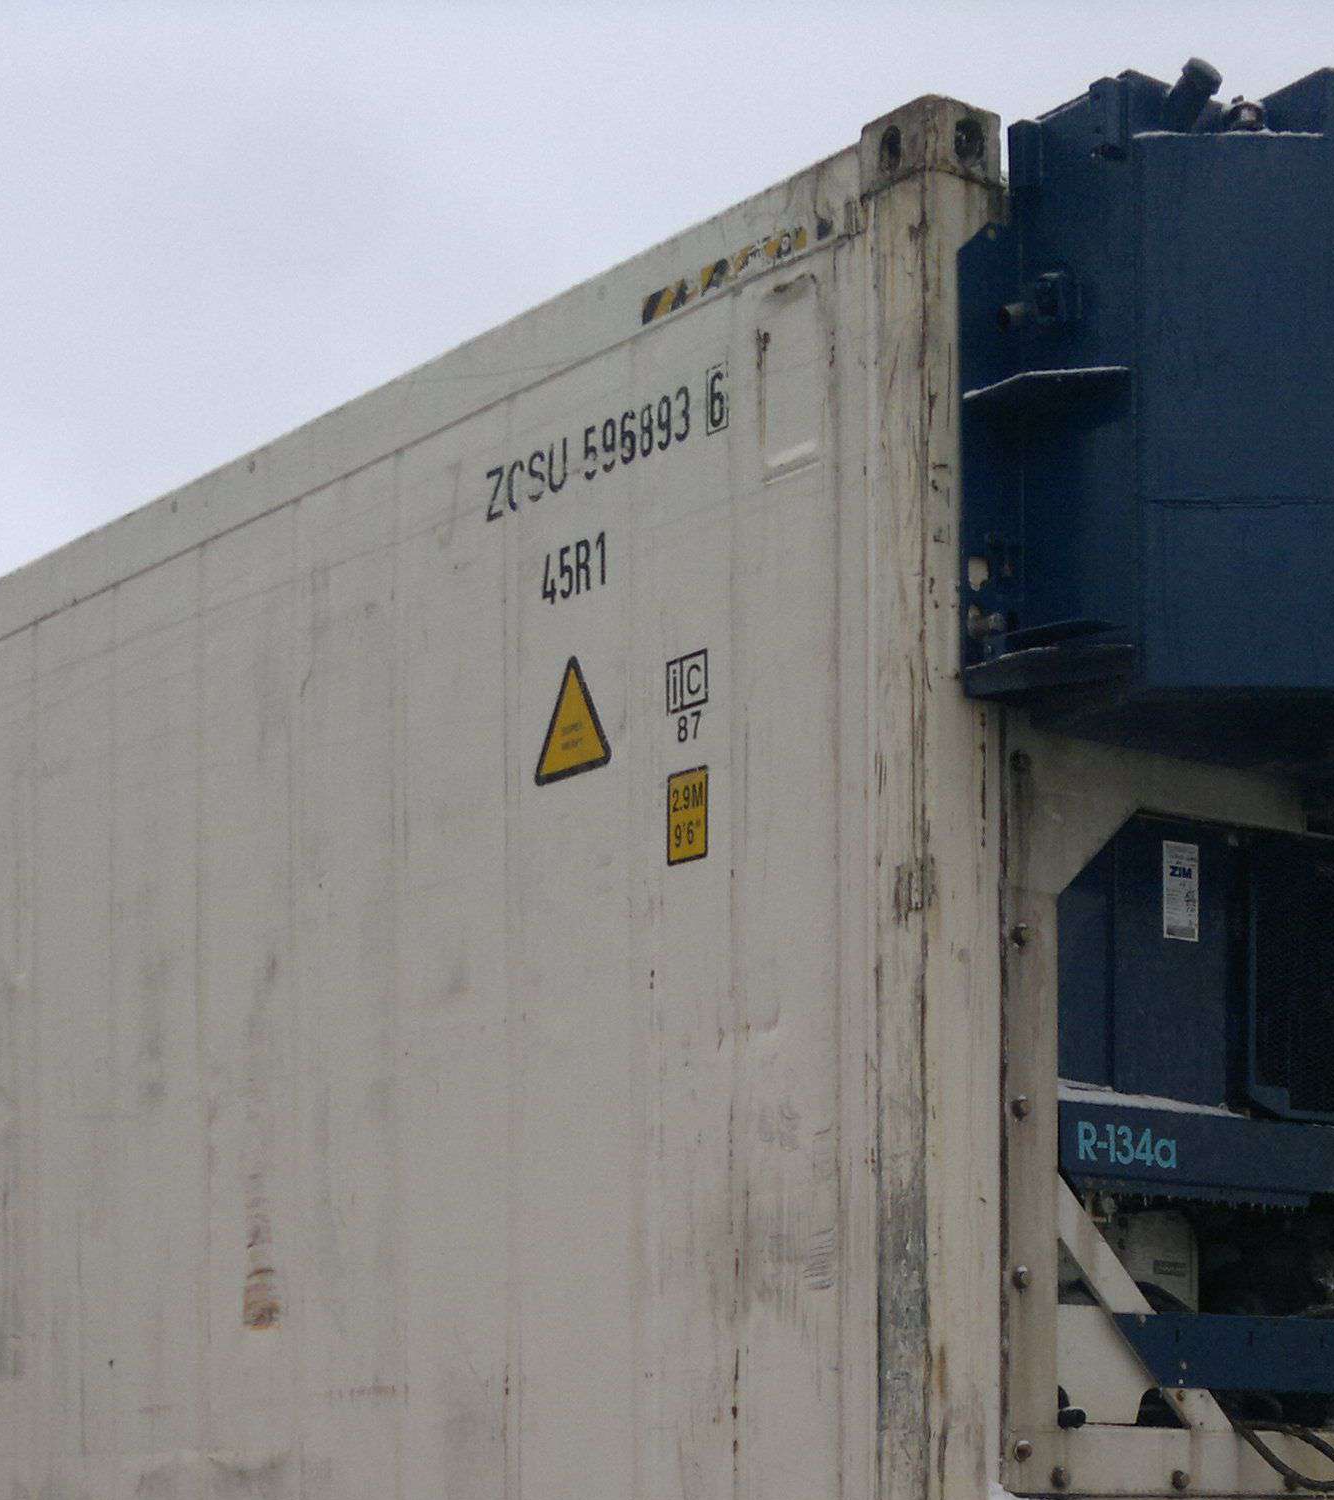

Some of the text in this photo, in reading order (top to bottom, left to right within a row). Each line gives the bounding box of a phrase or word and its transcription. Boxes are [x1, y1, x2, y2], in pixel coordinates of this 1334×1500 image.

[485, 369, 726, 522] ZCSU 596893 6
[541, 530, 606, 605] 45R1
[677, 710, 702, 743] 87
[672, 780, 703, 813] 2.9M
[1077, 1120, 1177, 1168] R-134a
